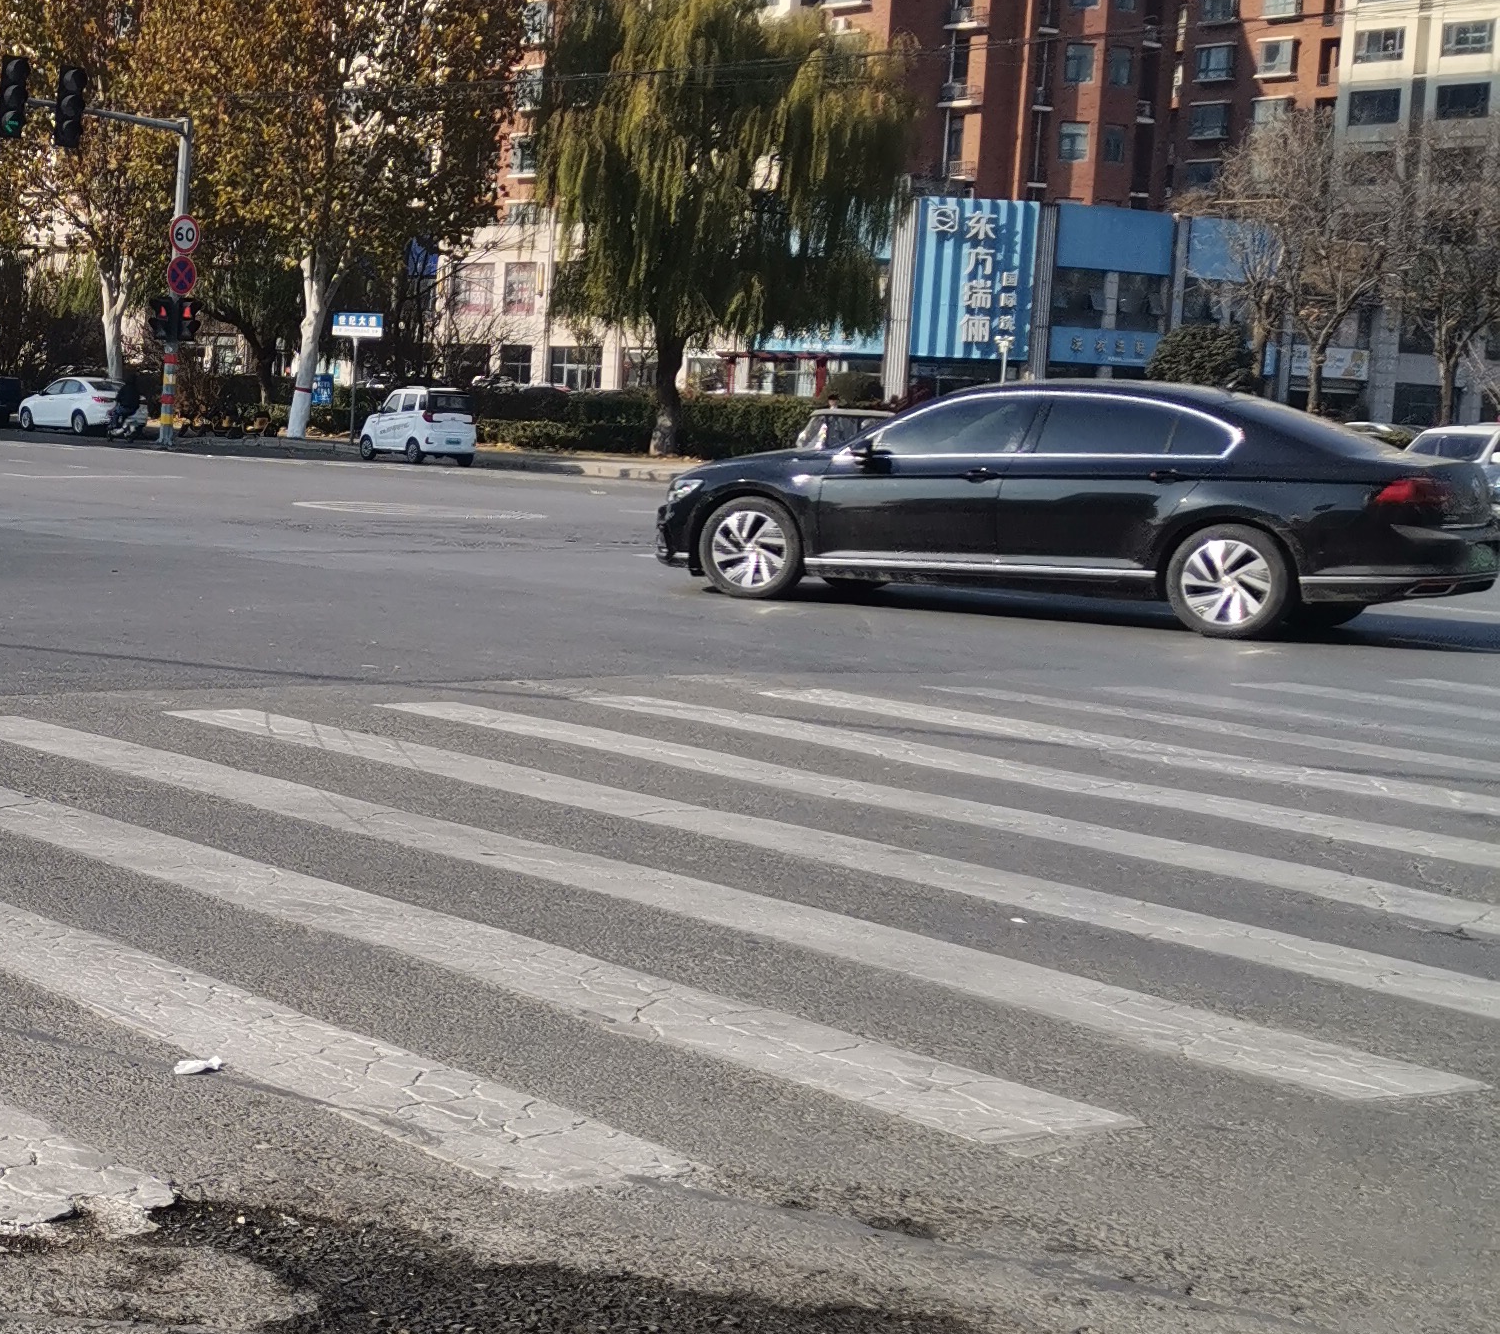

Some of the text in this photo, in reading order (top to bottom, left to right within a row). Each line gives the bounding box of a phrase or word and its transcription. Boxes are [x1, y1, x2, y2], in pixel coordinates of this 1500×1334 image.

[175, 226, 195, 243] 60
[960, 210, 998, 343] 东方瑞俪
